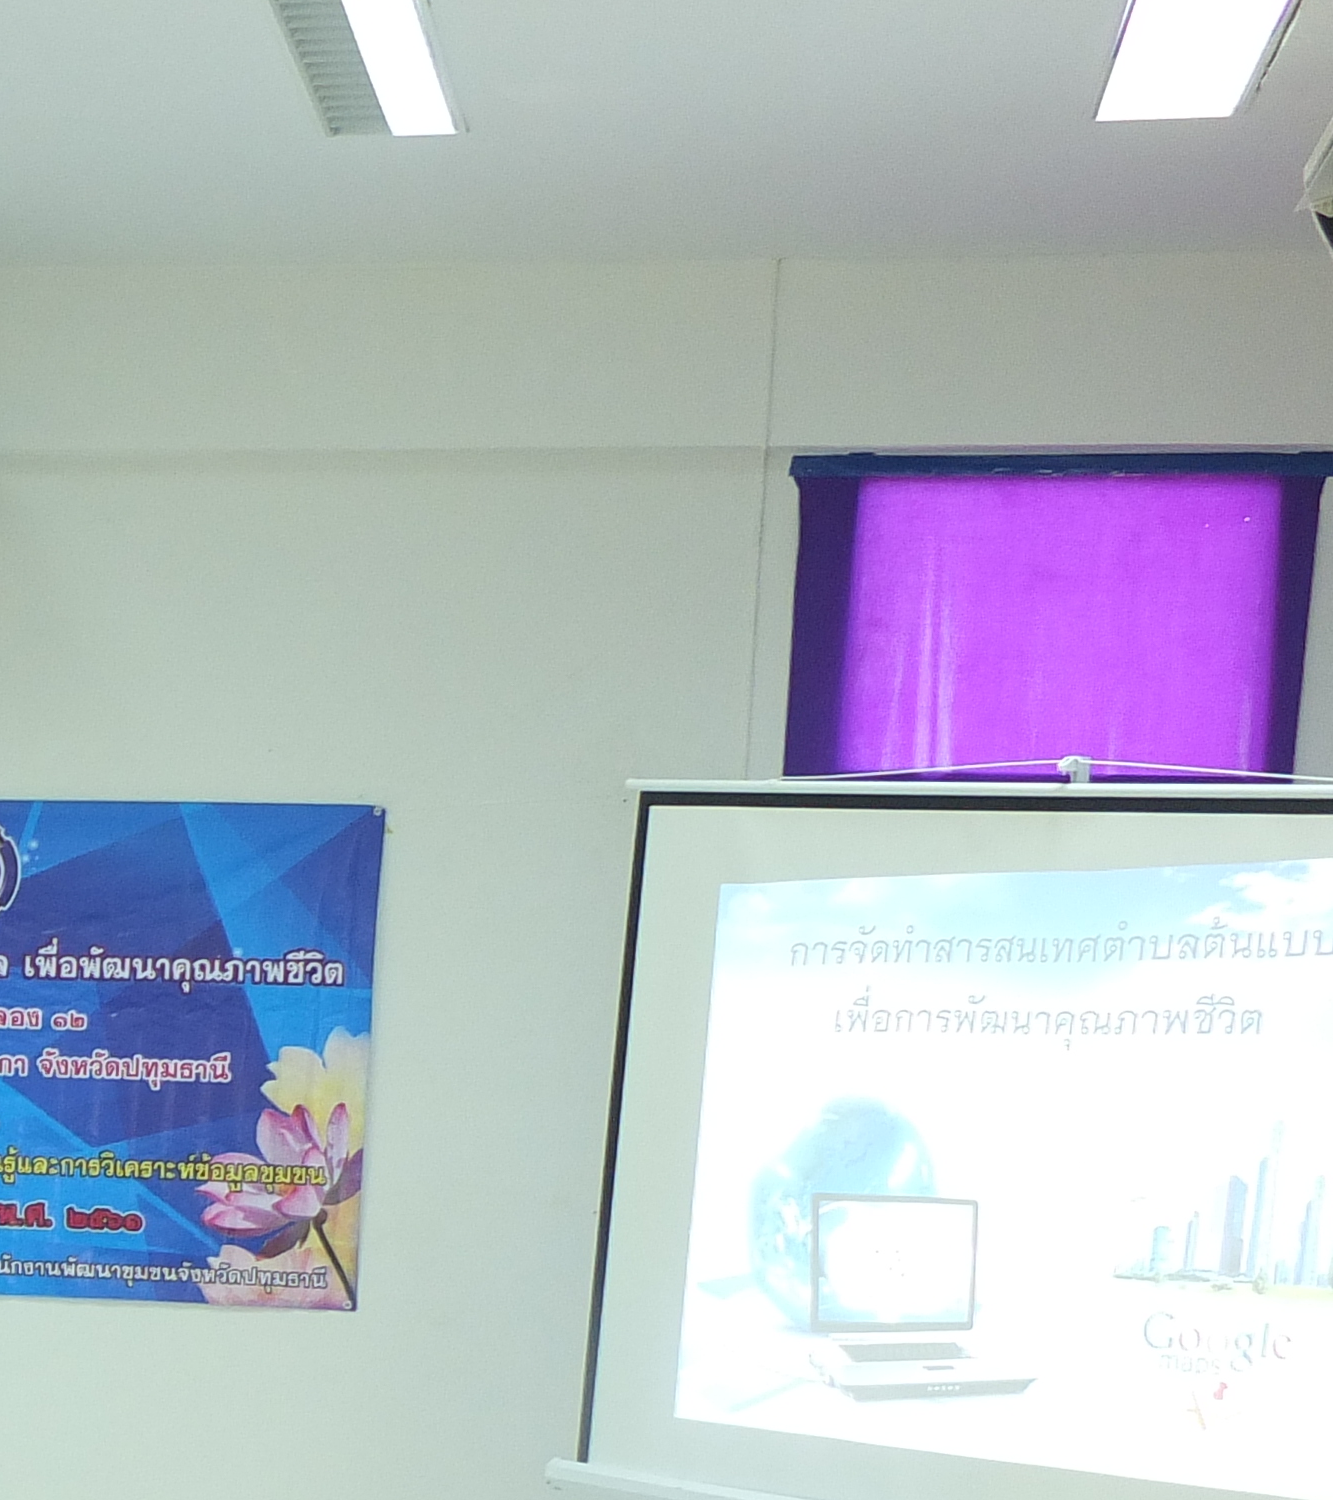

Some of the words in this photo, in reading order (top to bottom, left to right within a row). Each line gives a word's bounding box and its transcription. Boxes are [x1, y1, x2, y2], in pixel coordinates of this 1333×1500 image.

[24, 938, 344, 991] เพื่อพัฒนาคุณภาพชีวิต
[52, 1010, 87, 1030] ๑๒
[835, 985, 1263, 1051] เพื่อการพัฒนาคุณภาพชีวิต
[38, 1048, 231, 1090] จังหวัดปทุมธานี
[1144, 1311, 1292, 1373] Google
